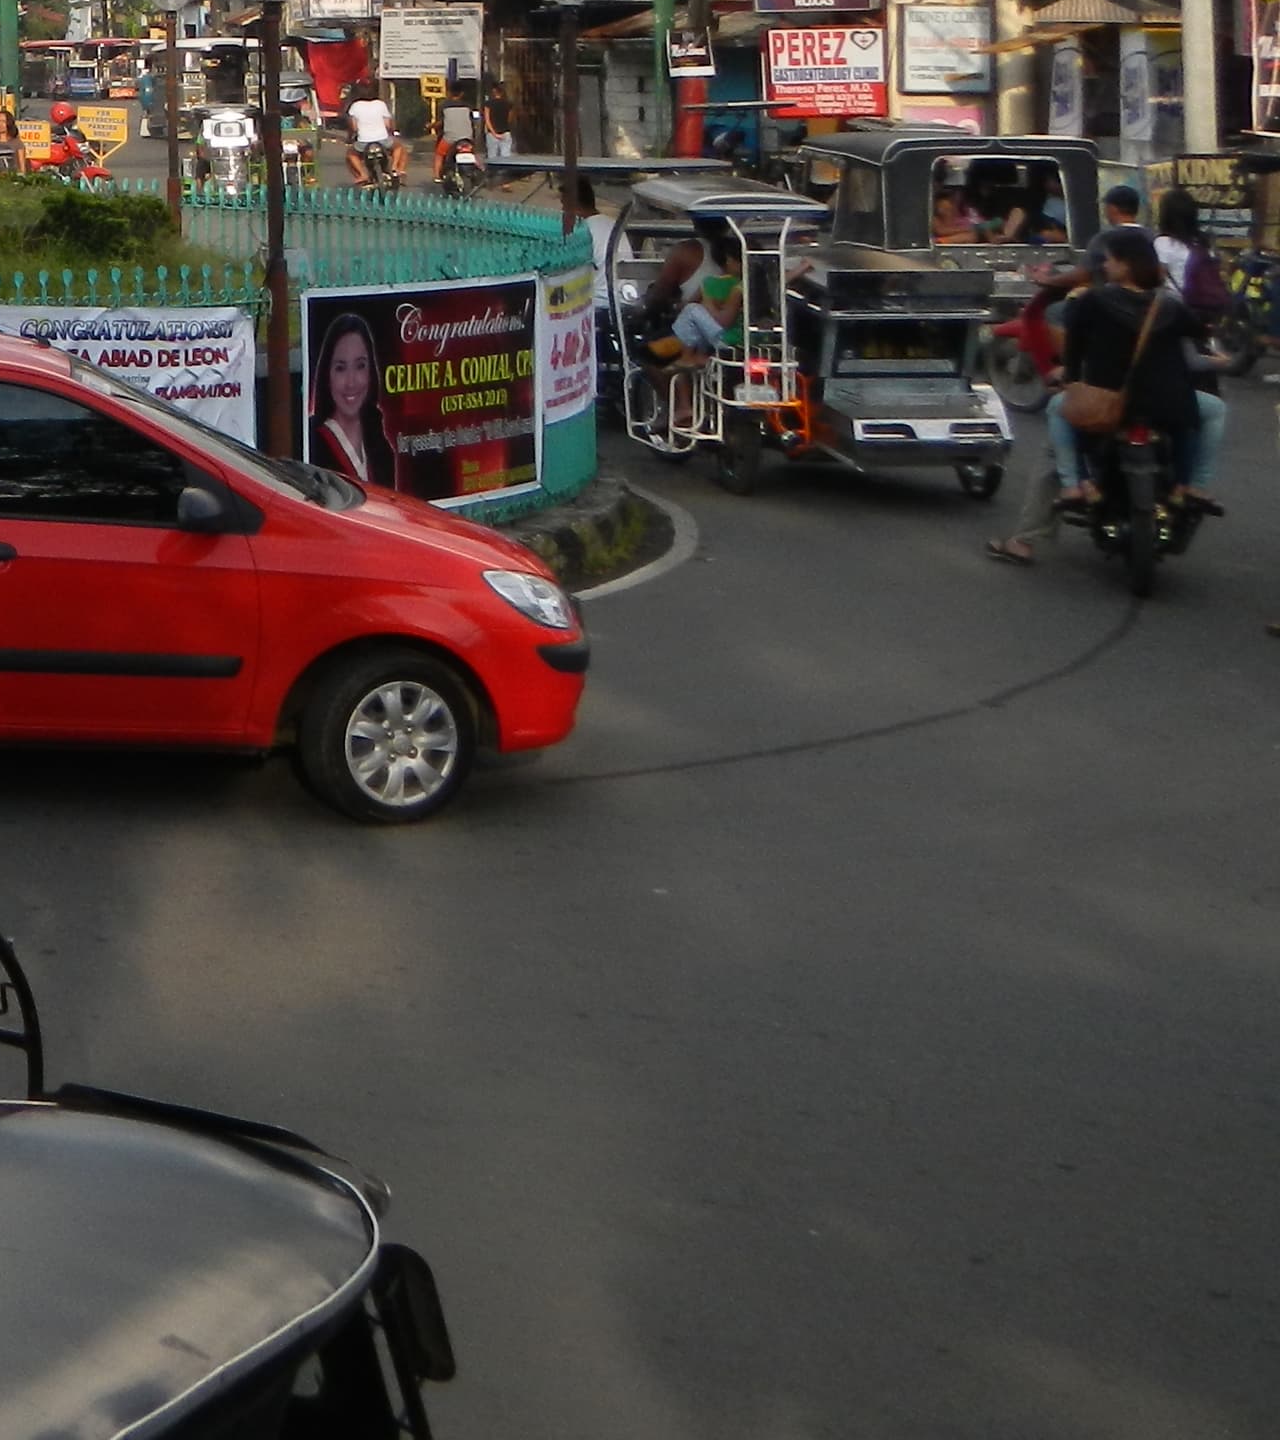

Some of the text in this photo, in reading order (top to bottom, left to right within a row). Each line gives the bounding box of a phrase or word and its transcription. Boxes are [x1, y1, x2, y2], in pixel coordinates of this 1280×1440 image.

[771, 31, 848, 66] PEREZ
[1178, 158, 1244, 185] KIDNE
[395, 298, 531, 357] Congratulations!
[96, 348, 154, 368] ABIAD
[157, 348, 181, 368] DE
[184, 347, 229, 367] LEON
[385, 361, 440, 393] CELINE
